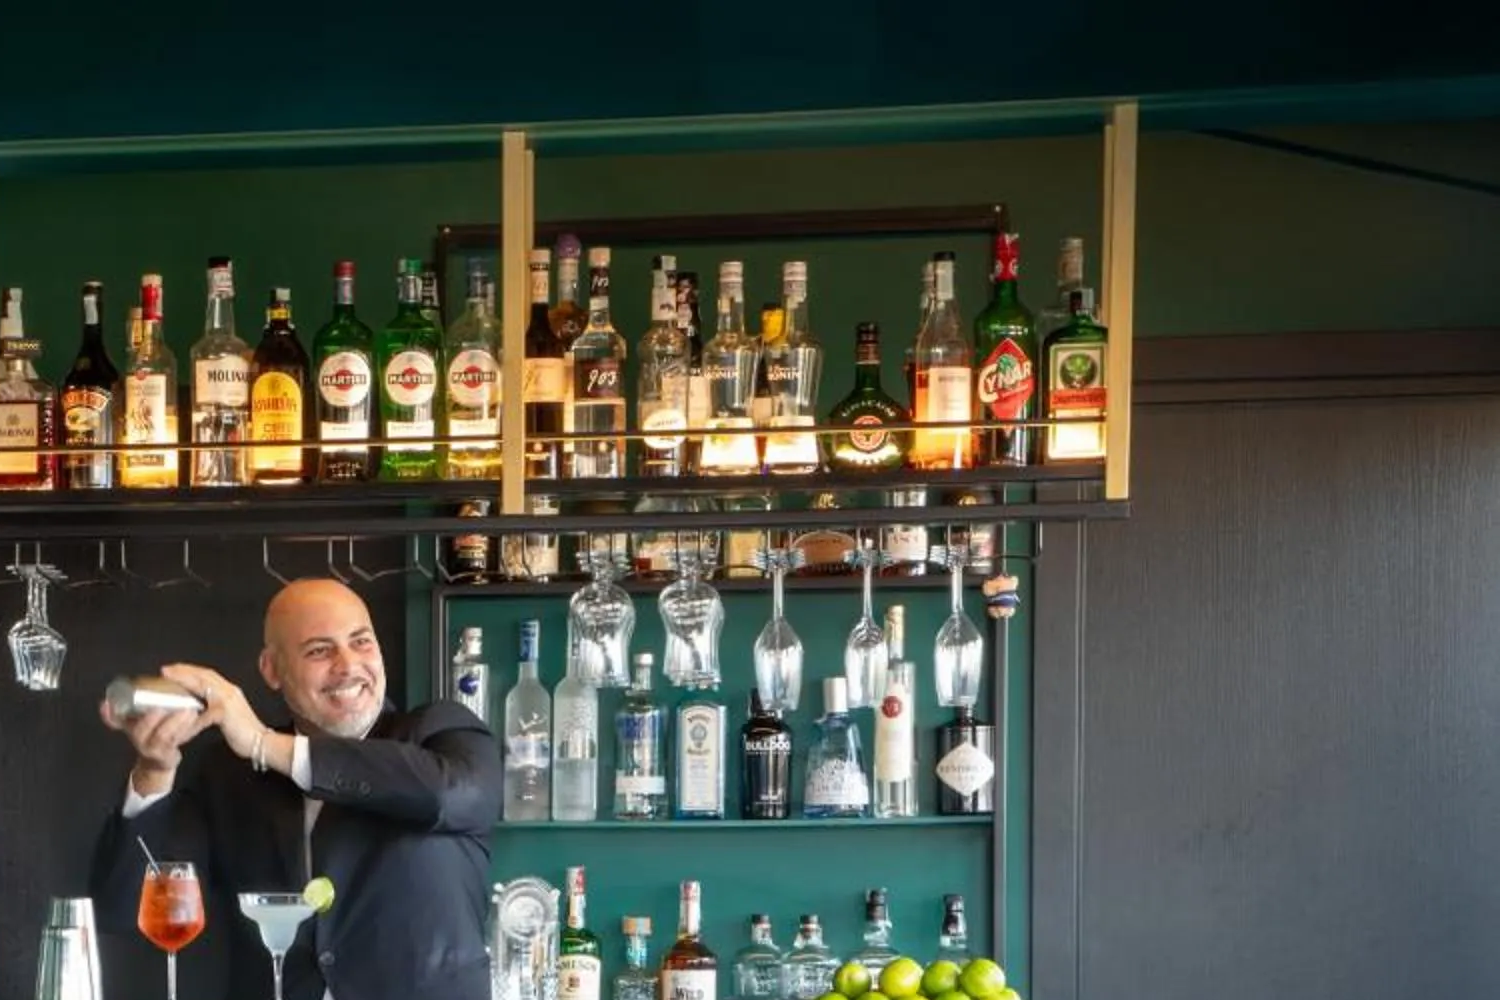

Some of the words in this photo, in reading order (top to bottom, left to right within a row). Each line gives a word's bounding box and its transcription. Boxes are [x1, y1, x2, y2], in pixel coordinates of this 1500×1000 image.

[207, 369, 248, 383] MOLIN
[323, 374, 366, 386] MARTINI
[388, 373, 433, 385] MARTINI
[453, 371, 496, 384] MARTINI
[978, 360, 1033, 402] CYNAR
[745, 740, 791, 750] BULLDOG
